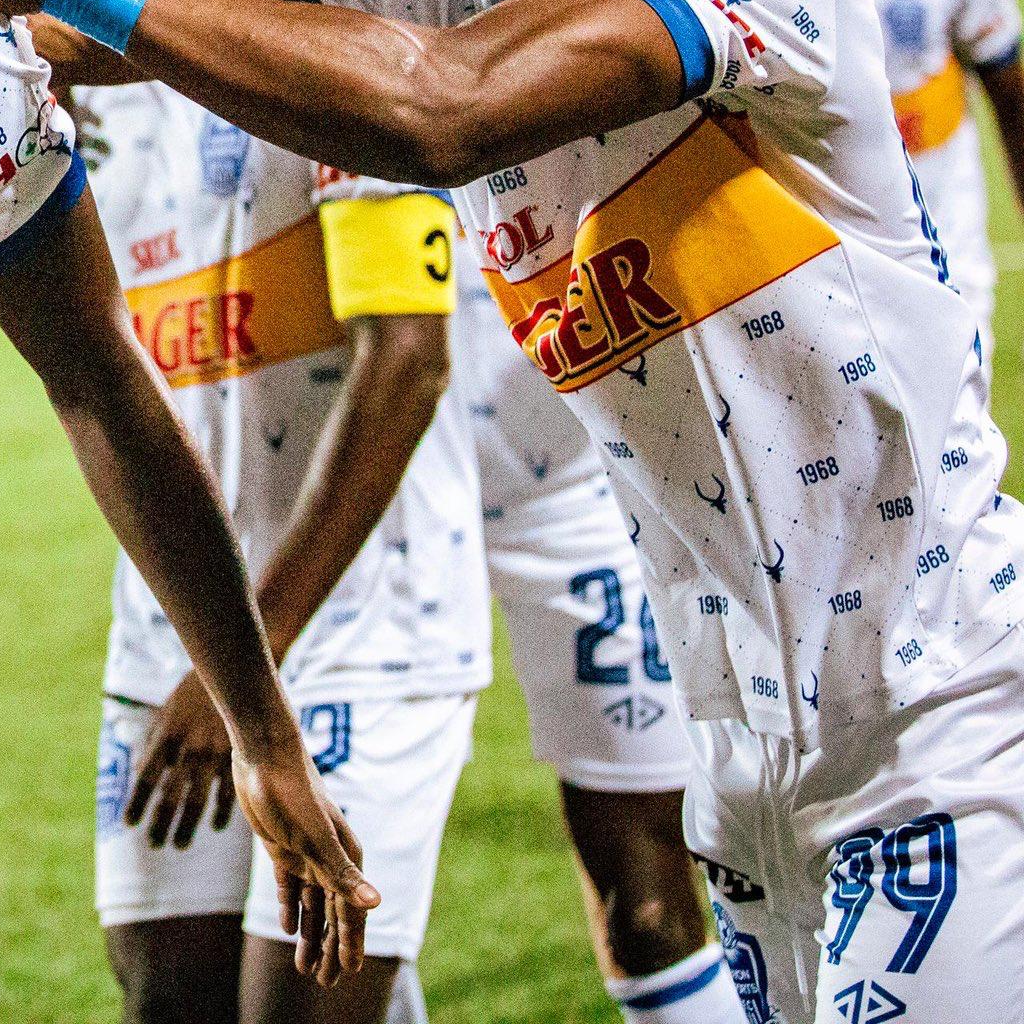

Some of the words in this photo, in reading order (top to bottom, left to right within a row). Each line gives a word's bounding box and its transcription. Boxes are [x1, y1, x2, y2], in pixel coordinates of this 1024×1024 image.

[791, 4, 820, 43] 1968
[486, 166, 528, 196] 1968
[424, 229, 452, 283] C
[133, 290, 258, 372] GER
[741, 310, 785, 341] 1968
[838, 353, 876, 385] 1968
[796, 456, 840, 486] 1968
[876, 495, 914, 520] 1968
[989, 563, 1017, 594] 1968
[697, 595, 729, 616] 1968
[828, 589, 862, 615] 1968
[895, 638, 923, 668] 1968
[751, 675, 779, 699] 1968
[826, 812, 958, 974] 99
